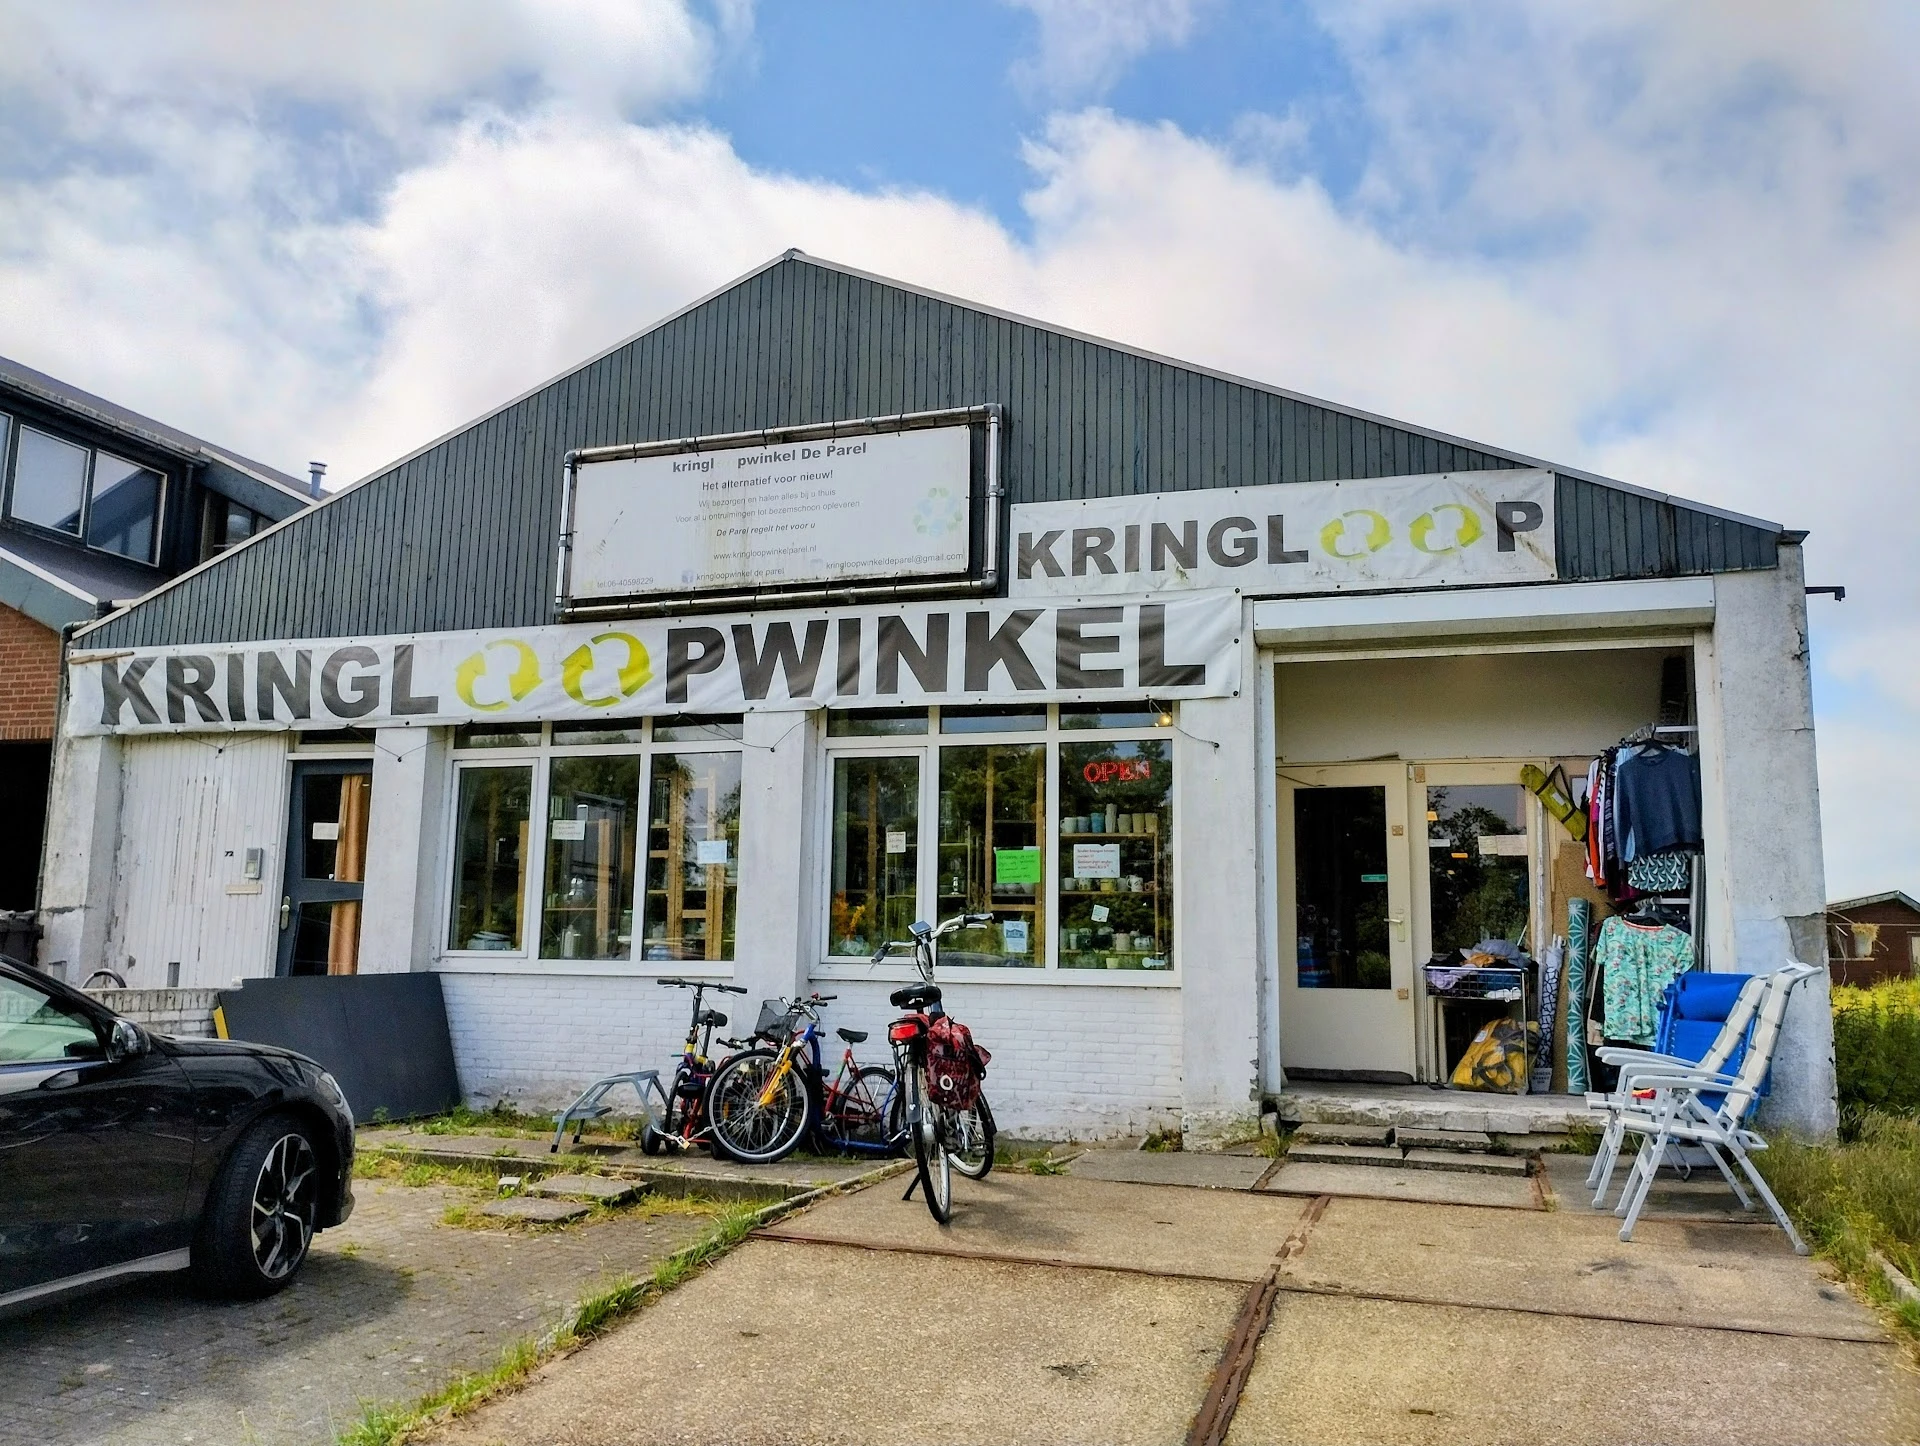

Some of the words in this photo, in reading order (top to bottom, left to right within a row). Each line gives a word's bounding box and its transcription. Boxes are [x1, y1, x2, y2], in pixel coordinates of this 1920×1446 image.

[802, 448, 821, 460] De
[826, 442, 867, 457] Parel
[702, 482, 719, 491] Het
[722, 476, 772, 490] alternatief
[774, 475, 797, 484] voor
[800, 470, 833, 481] nieuw!
[712, 498, 746, 507] bezorgen
[759, 494, 779, 502] halen
[781, 492, 798, 500] alles
[800, 491, 809, 500] bij
[675, 515, 692, 523] Voor
[708, 510, 756, 519] ontruimingen
[758, 508, 767, 516] tot
[768, 504, 820, 515] bezemschoon
[822, 500, 860, 511] opleveren
[716, 528, 727, 536] De
[728, 526, 750, 536] Parel
[750, 524, 774, 534] regelt
[713, 545, 817, 560] www.kringloopwinkelparel.nl
[1017, 514, 1308, 580] KRINGL
[826, 552, 964, 570] kringloopwinkeldeparel@gmail.com
[696, 569, 752, 582] kringloopwinkel
[754, 569, 764, 577] de
[765, 568, 785, 576] parel
[101, 644, 438, 726] KRINGL
[666, 604, 1206, 704] PWINKEL
[1083, 760, 1152, 783] OPEN
